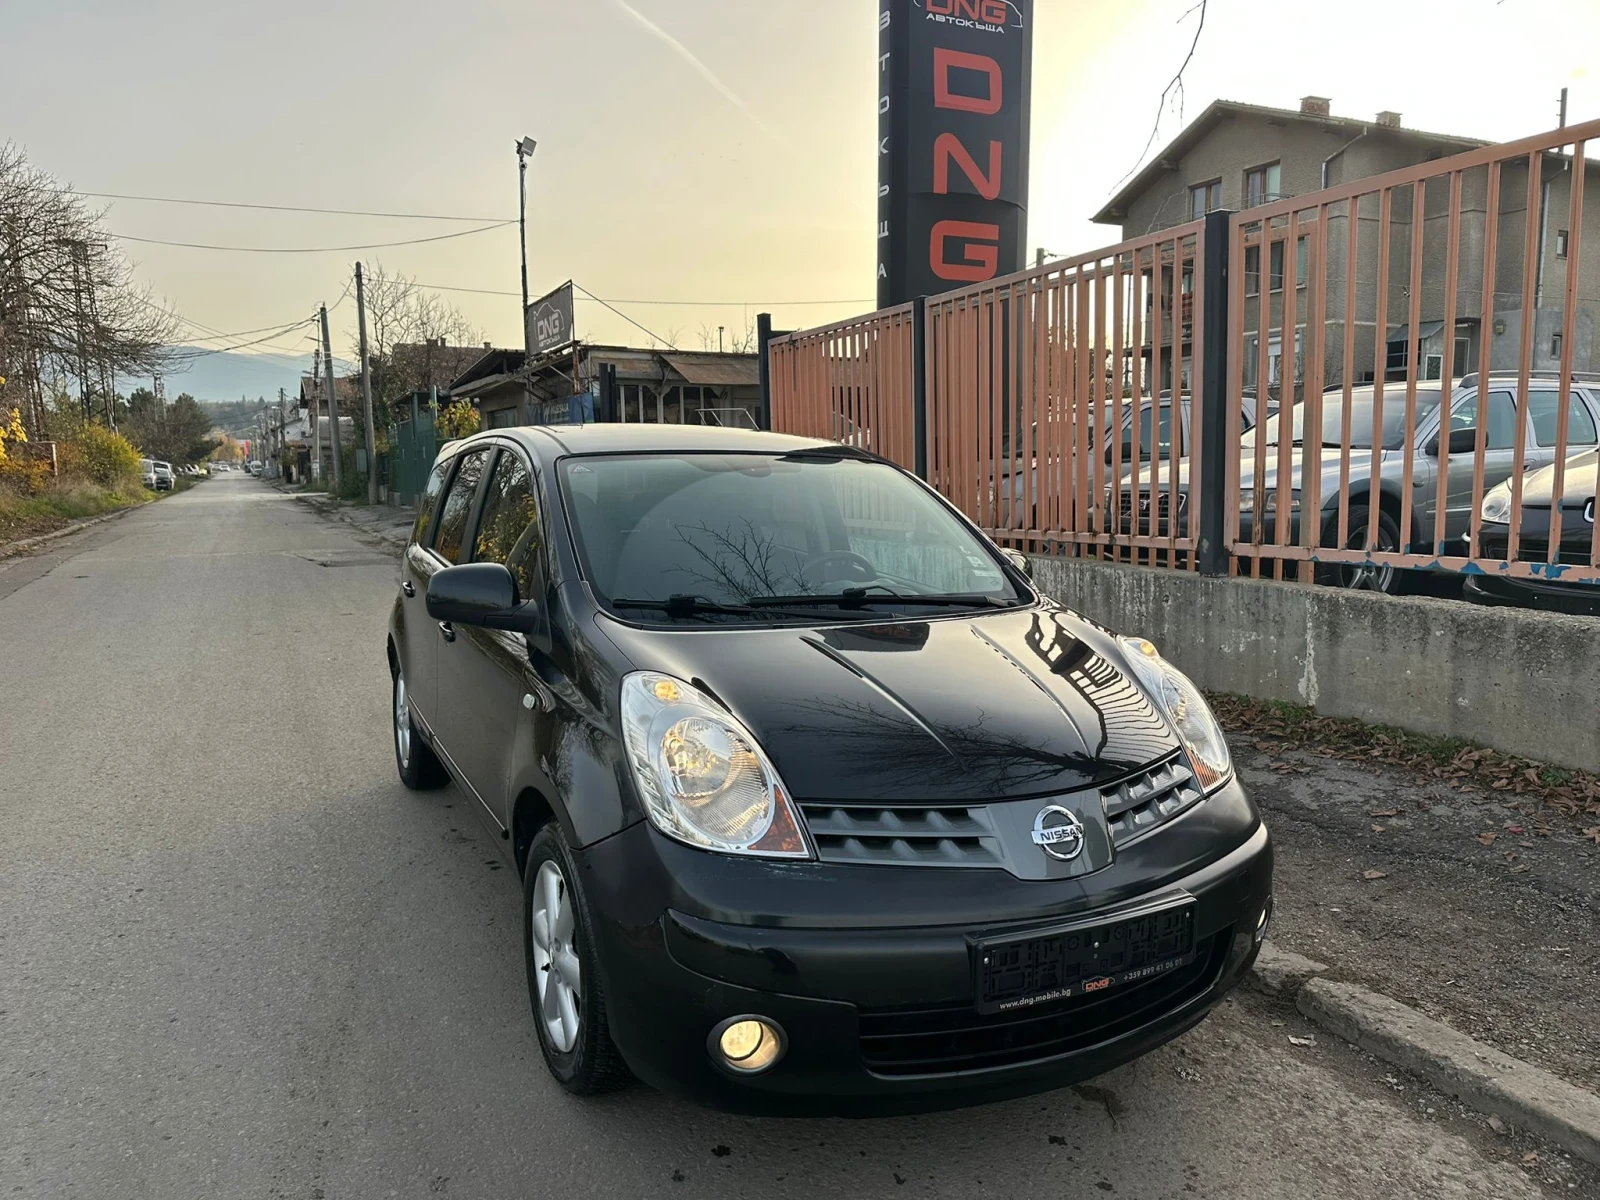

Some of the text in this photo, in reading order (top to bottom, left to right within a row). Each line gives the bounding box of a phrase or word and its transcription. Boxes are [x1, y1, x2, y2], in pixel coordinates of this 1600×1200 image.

[926, 0, 1006, 24] DNG
[929, 47, 1002, 283] DNG
[537, 312, 560, 340] DNG
[1039, 826, 1084, 842] NISSAN
[1123, 970, 1141, 981] +359
[1142, 966, 1155, 976] 899
[1155, 963, 1164, 972] 41
[999, 988, 1072, 1009] www.dng.mobile.bg
